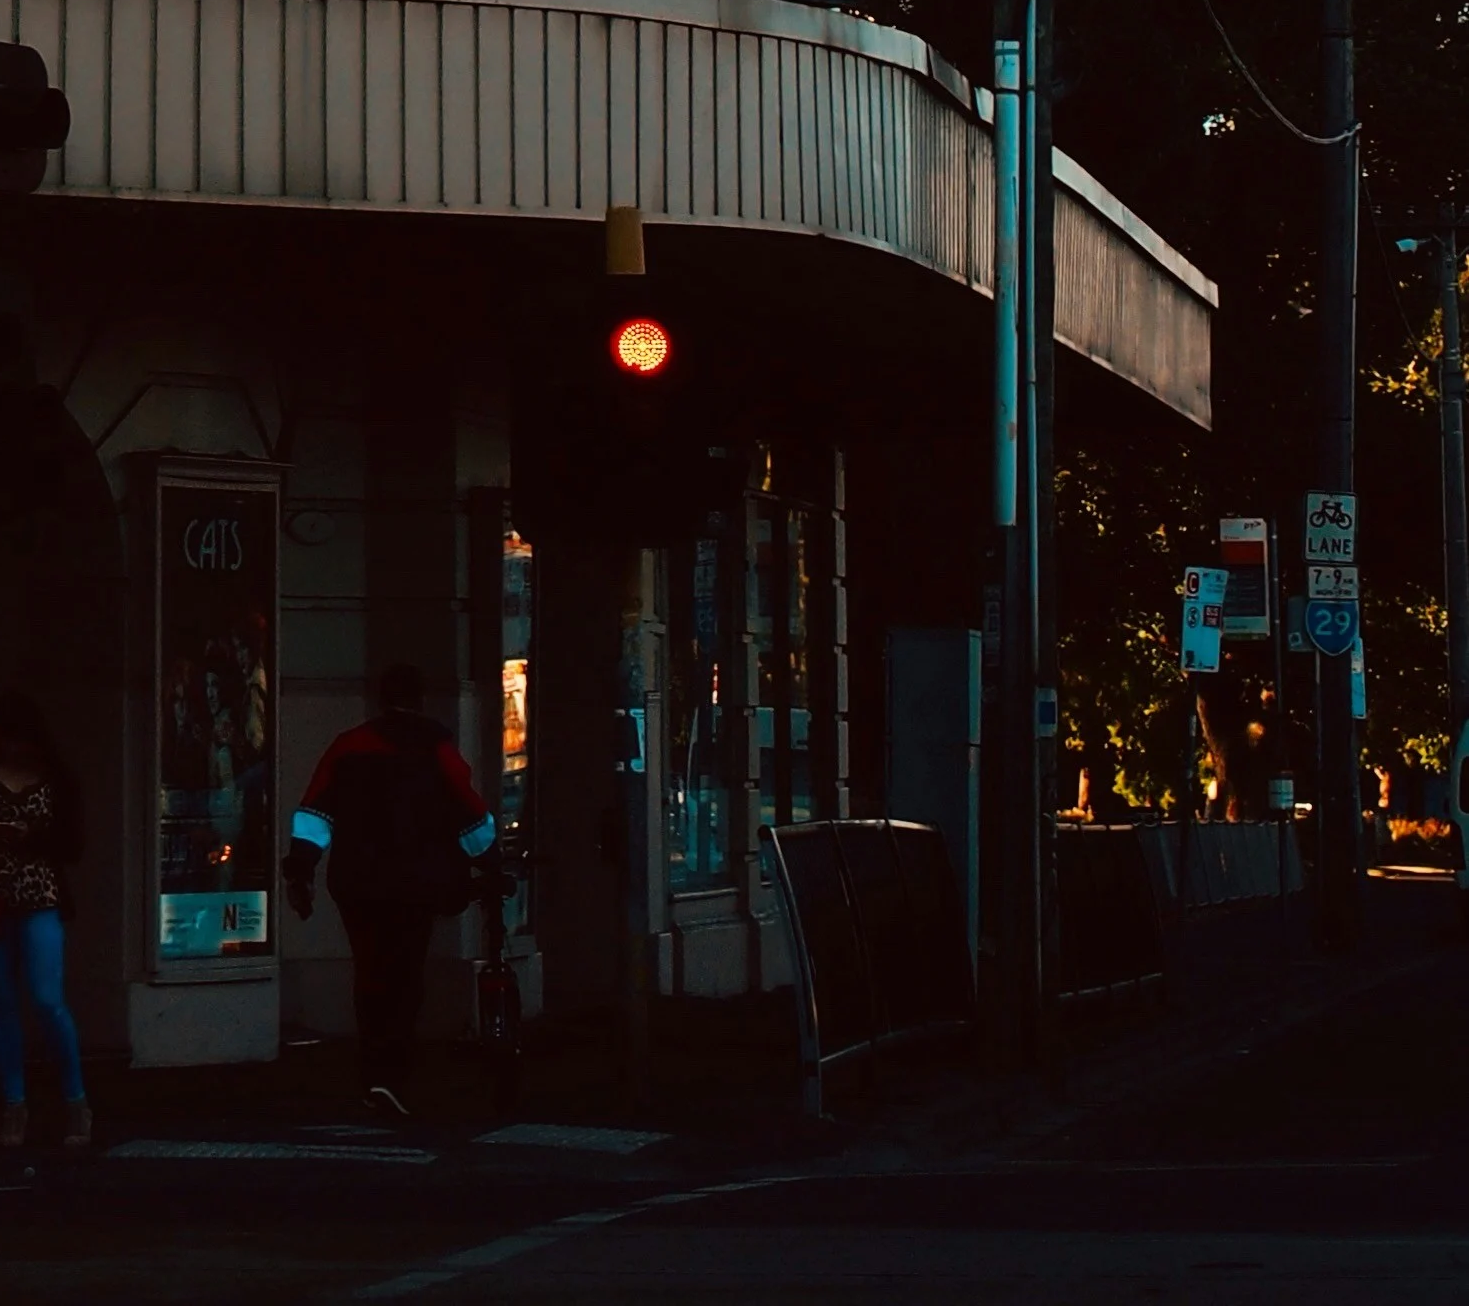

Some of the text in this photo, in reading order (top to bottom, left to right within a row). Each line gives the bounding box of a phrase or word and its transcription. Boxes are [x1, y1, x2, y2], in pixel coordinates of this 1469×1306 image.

[183, 517, 243, 571] CATS
[1308, 538, 1352, 555] LANE
[1315, 609, 1351, 636] 29
